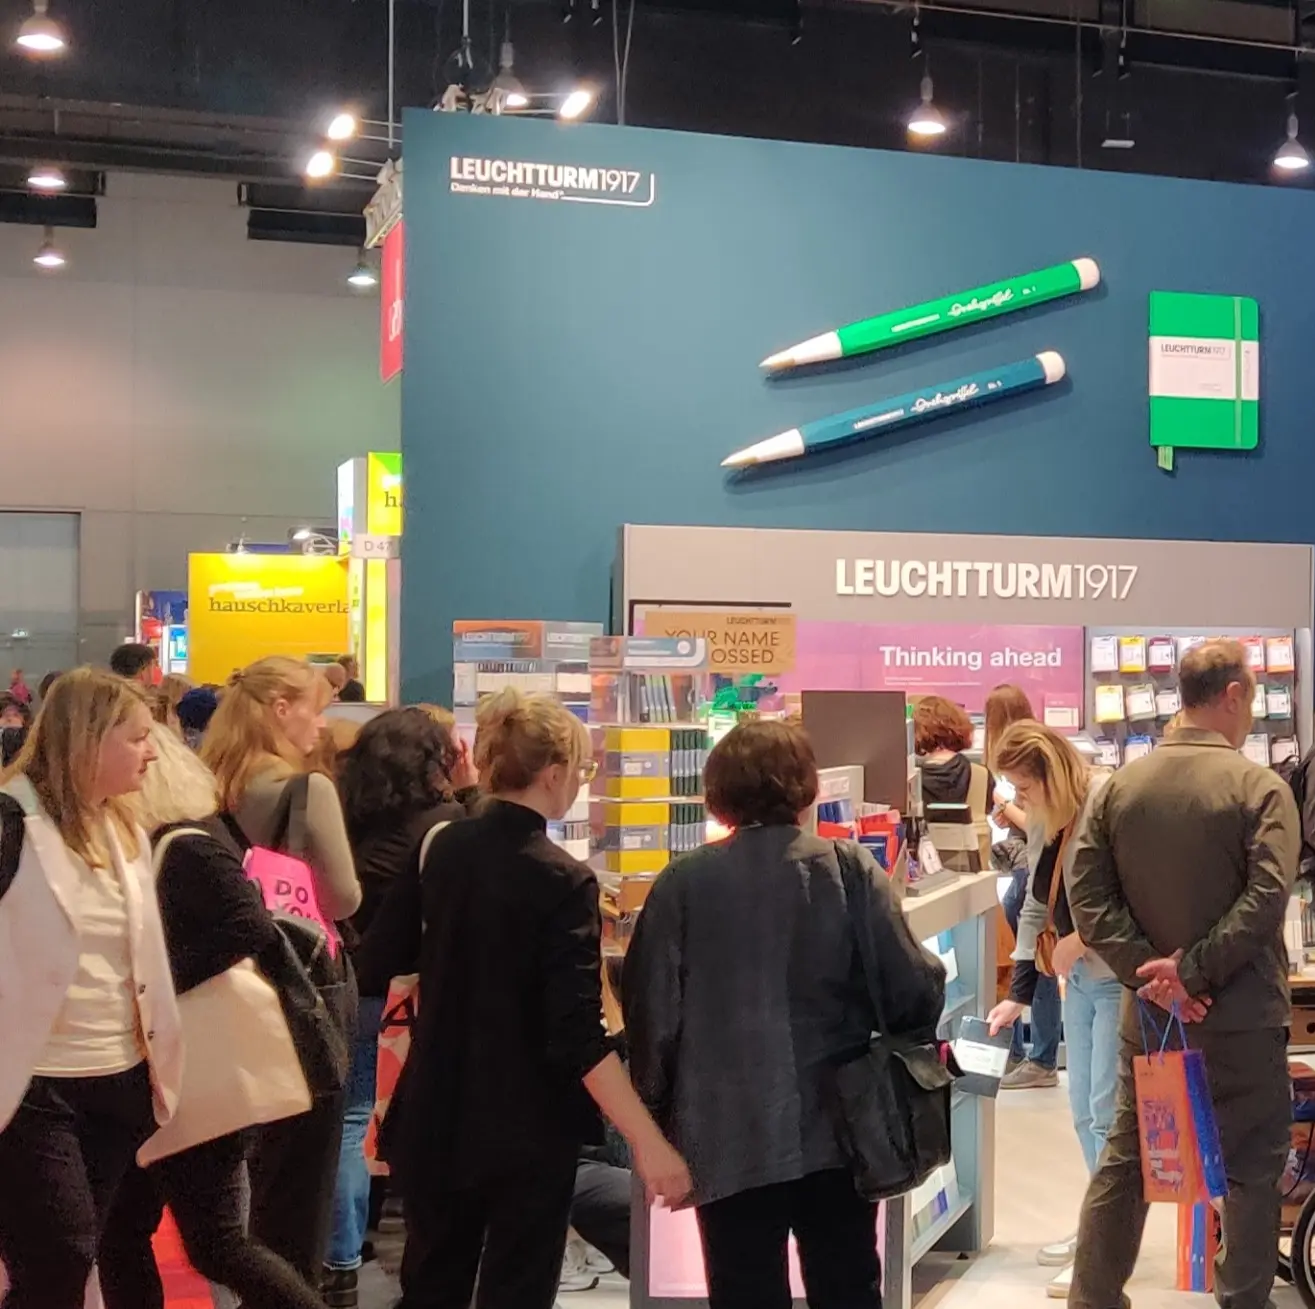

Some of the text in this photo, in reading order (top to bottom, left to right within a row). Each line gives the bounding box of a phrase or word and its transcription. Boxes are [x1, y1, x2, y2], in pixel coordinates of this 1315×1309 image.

[450, 157, 641, 193] LEUCHTTURM1917
[492, 186, 510, 196] mit
[511, 187, 530, 197] der
[364, 540, 375, 551] D
[835, 558, 1138, 600] LEUCHTTURM1917
[208, 597, 350, 614] hauschkaverla
[724, 631, 780, 646] NAME
[711, 648, 775, 664] OSSED
[879, 645, 1062, 671] Thinking ahead
[275, 879, 309, 905] DO
